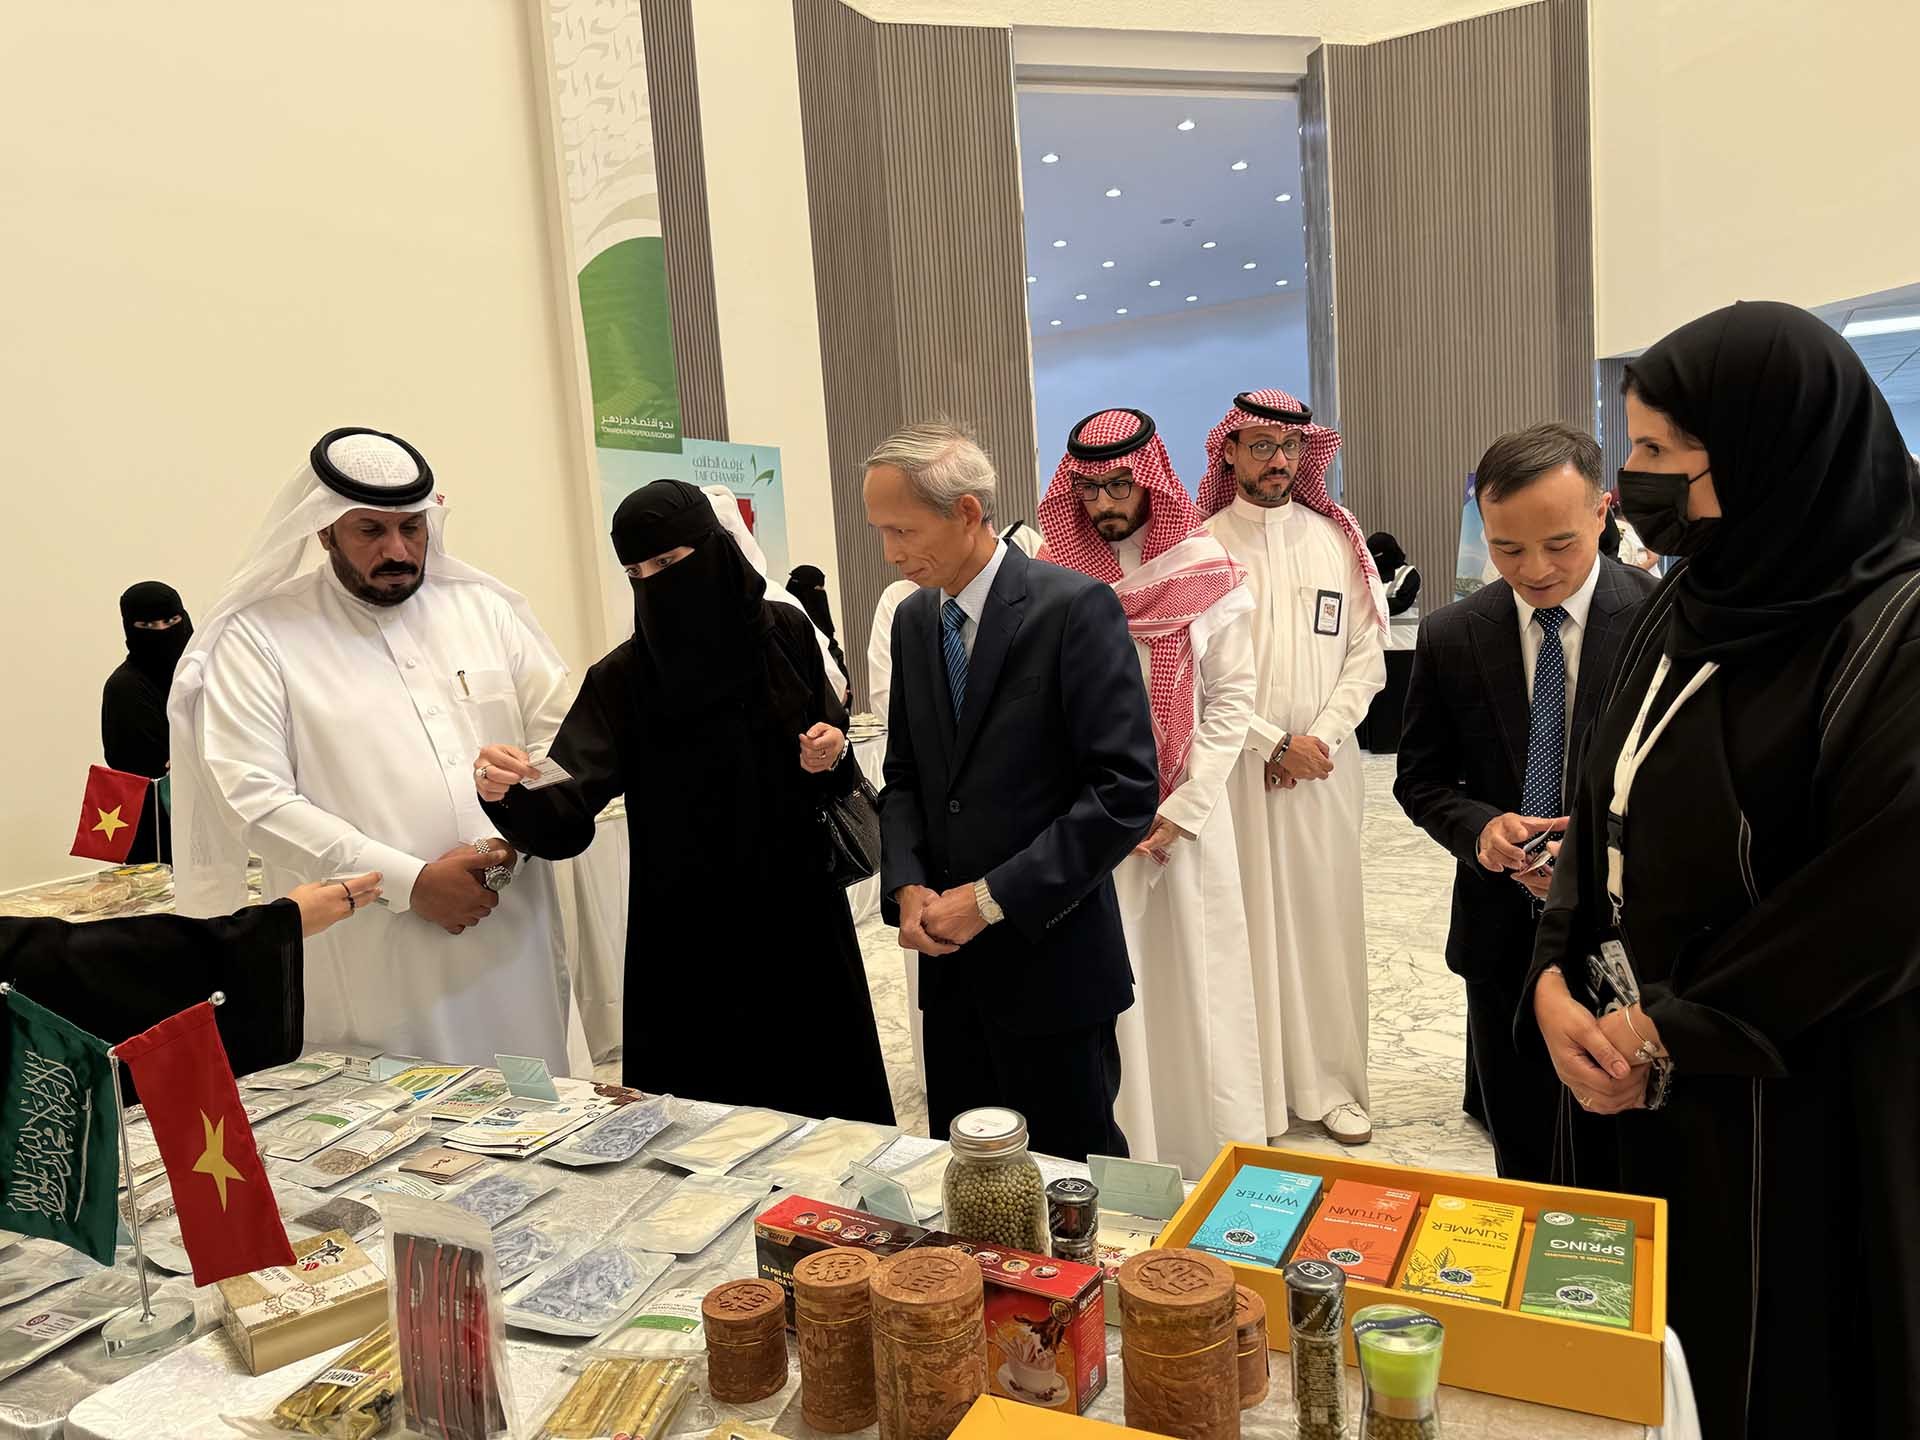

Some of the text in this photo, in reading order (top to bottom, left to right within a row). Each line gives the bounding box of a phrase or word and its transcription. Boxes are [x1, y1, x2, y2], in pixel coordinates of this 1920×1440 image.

[600, 415, 675, 430] نحو اقتصاد مزدهر
[1235, 1189, 1300, 1208] WINTER
[1328, 1205, 1402, 1223] AUTUMN
[768, 1231, 789, 1243] COFFEE
[1431, 1221, 1509, 1241] SUMMER
[1549, 1238, 1625, 1256] SPRING
